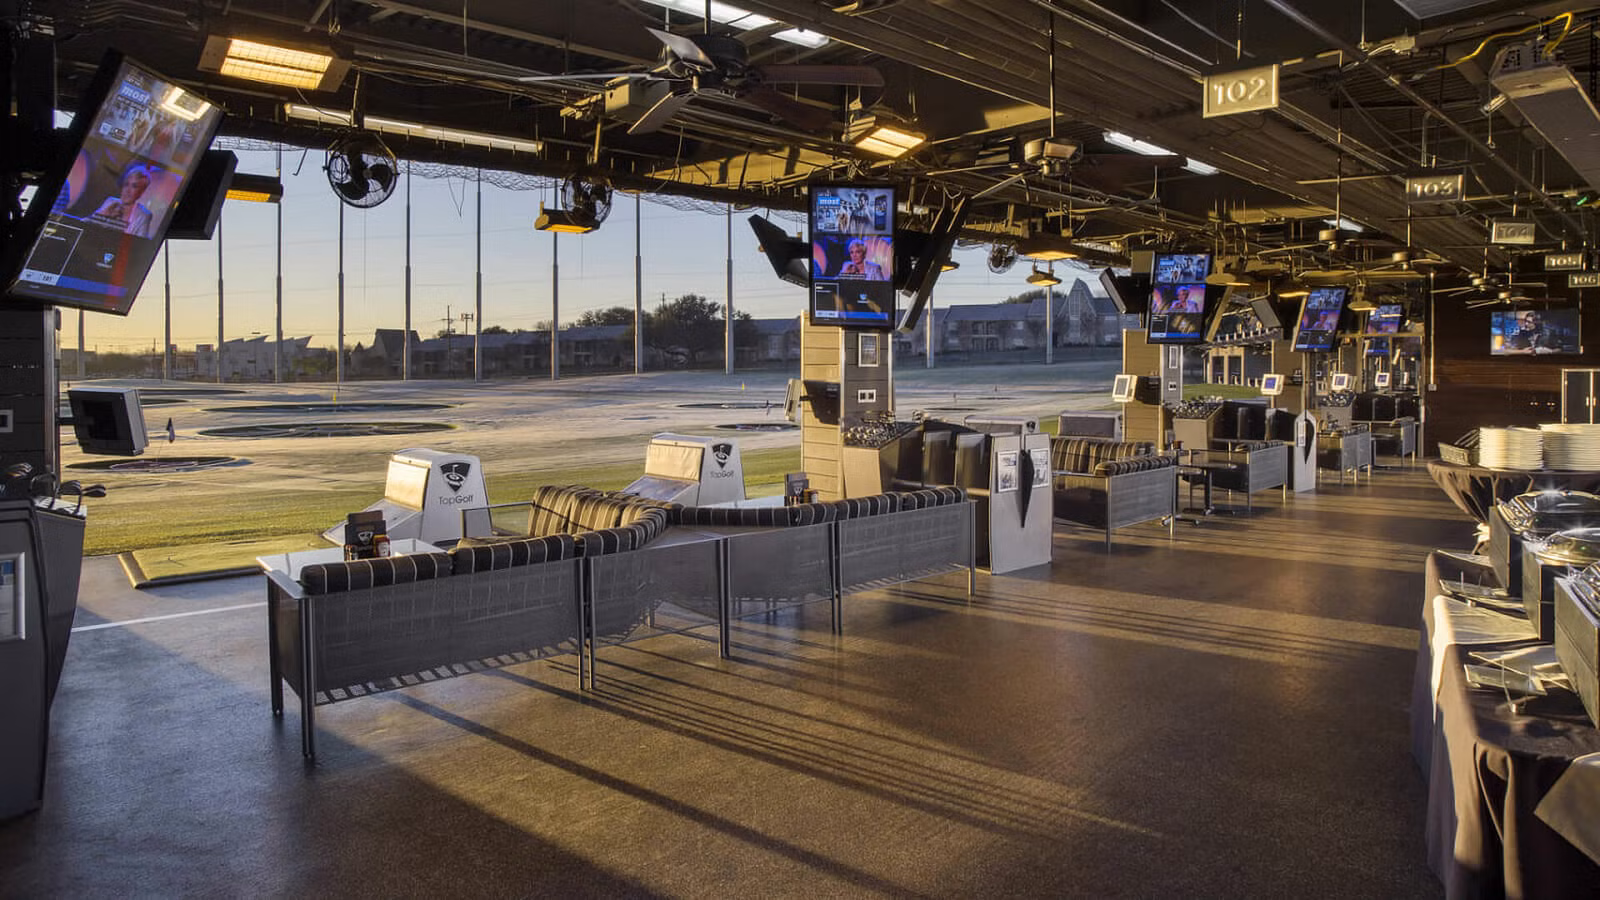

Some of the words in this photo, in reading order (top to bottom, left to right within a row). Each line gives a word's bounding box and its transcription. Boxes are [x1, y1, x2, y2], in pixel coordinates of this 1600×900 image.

[121, 85, 151, 105] most
[1213, 76, 1268, 105] 102
[1413, 177, 1453, 198] 103
[1572, 274, 1597, 285] 106
[438, 494, 474, 506] TopGolf
